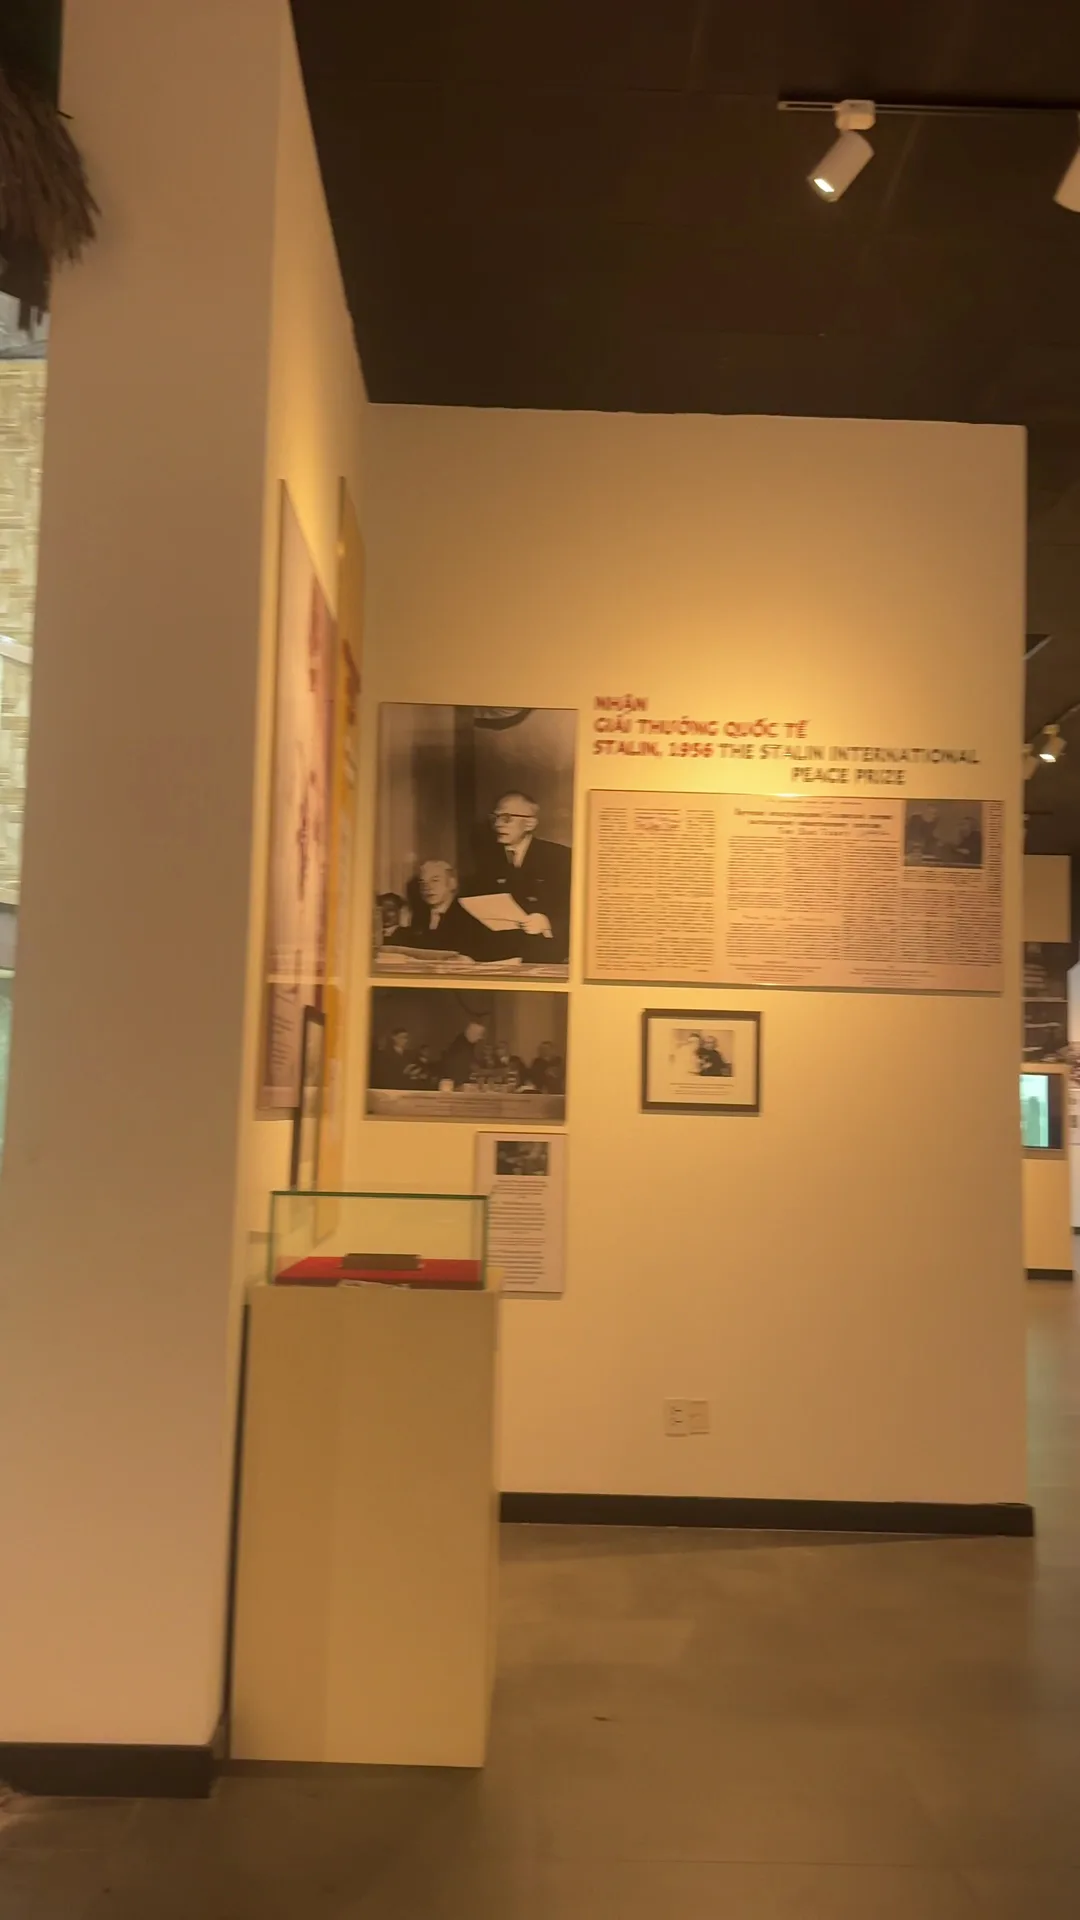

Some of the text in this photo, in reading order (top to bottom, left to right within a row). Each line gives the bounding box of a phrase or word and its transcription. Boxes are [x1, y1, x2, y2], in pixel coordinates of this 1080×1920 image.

[667, 742, 715, 757] 1956
[717, 743, 755, 759] THE
[759, 744, 825, 761] STALIN
[828, 746, 981, 765] INTERNATIONAL
[791, 766, 907, 785] PEACE PRIZE
